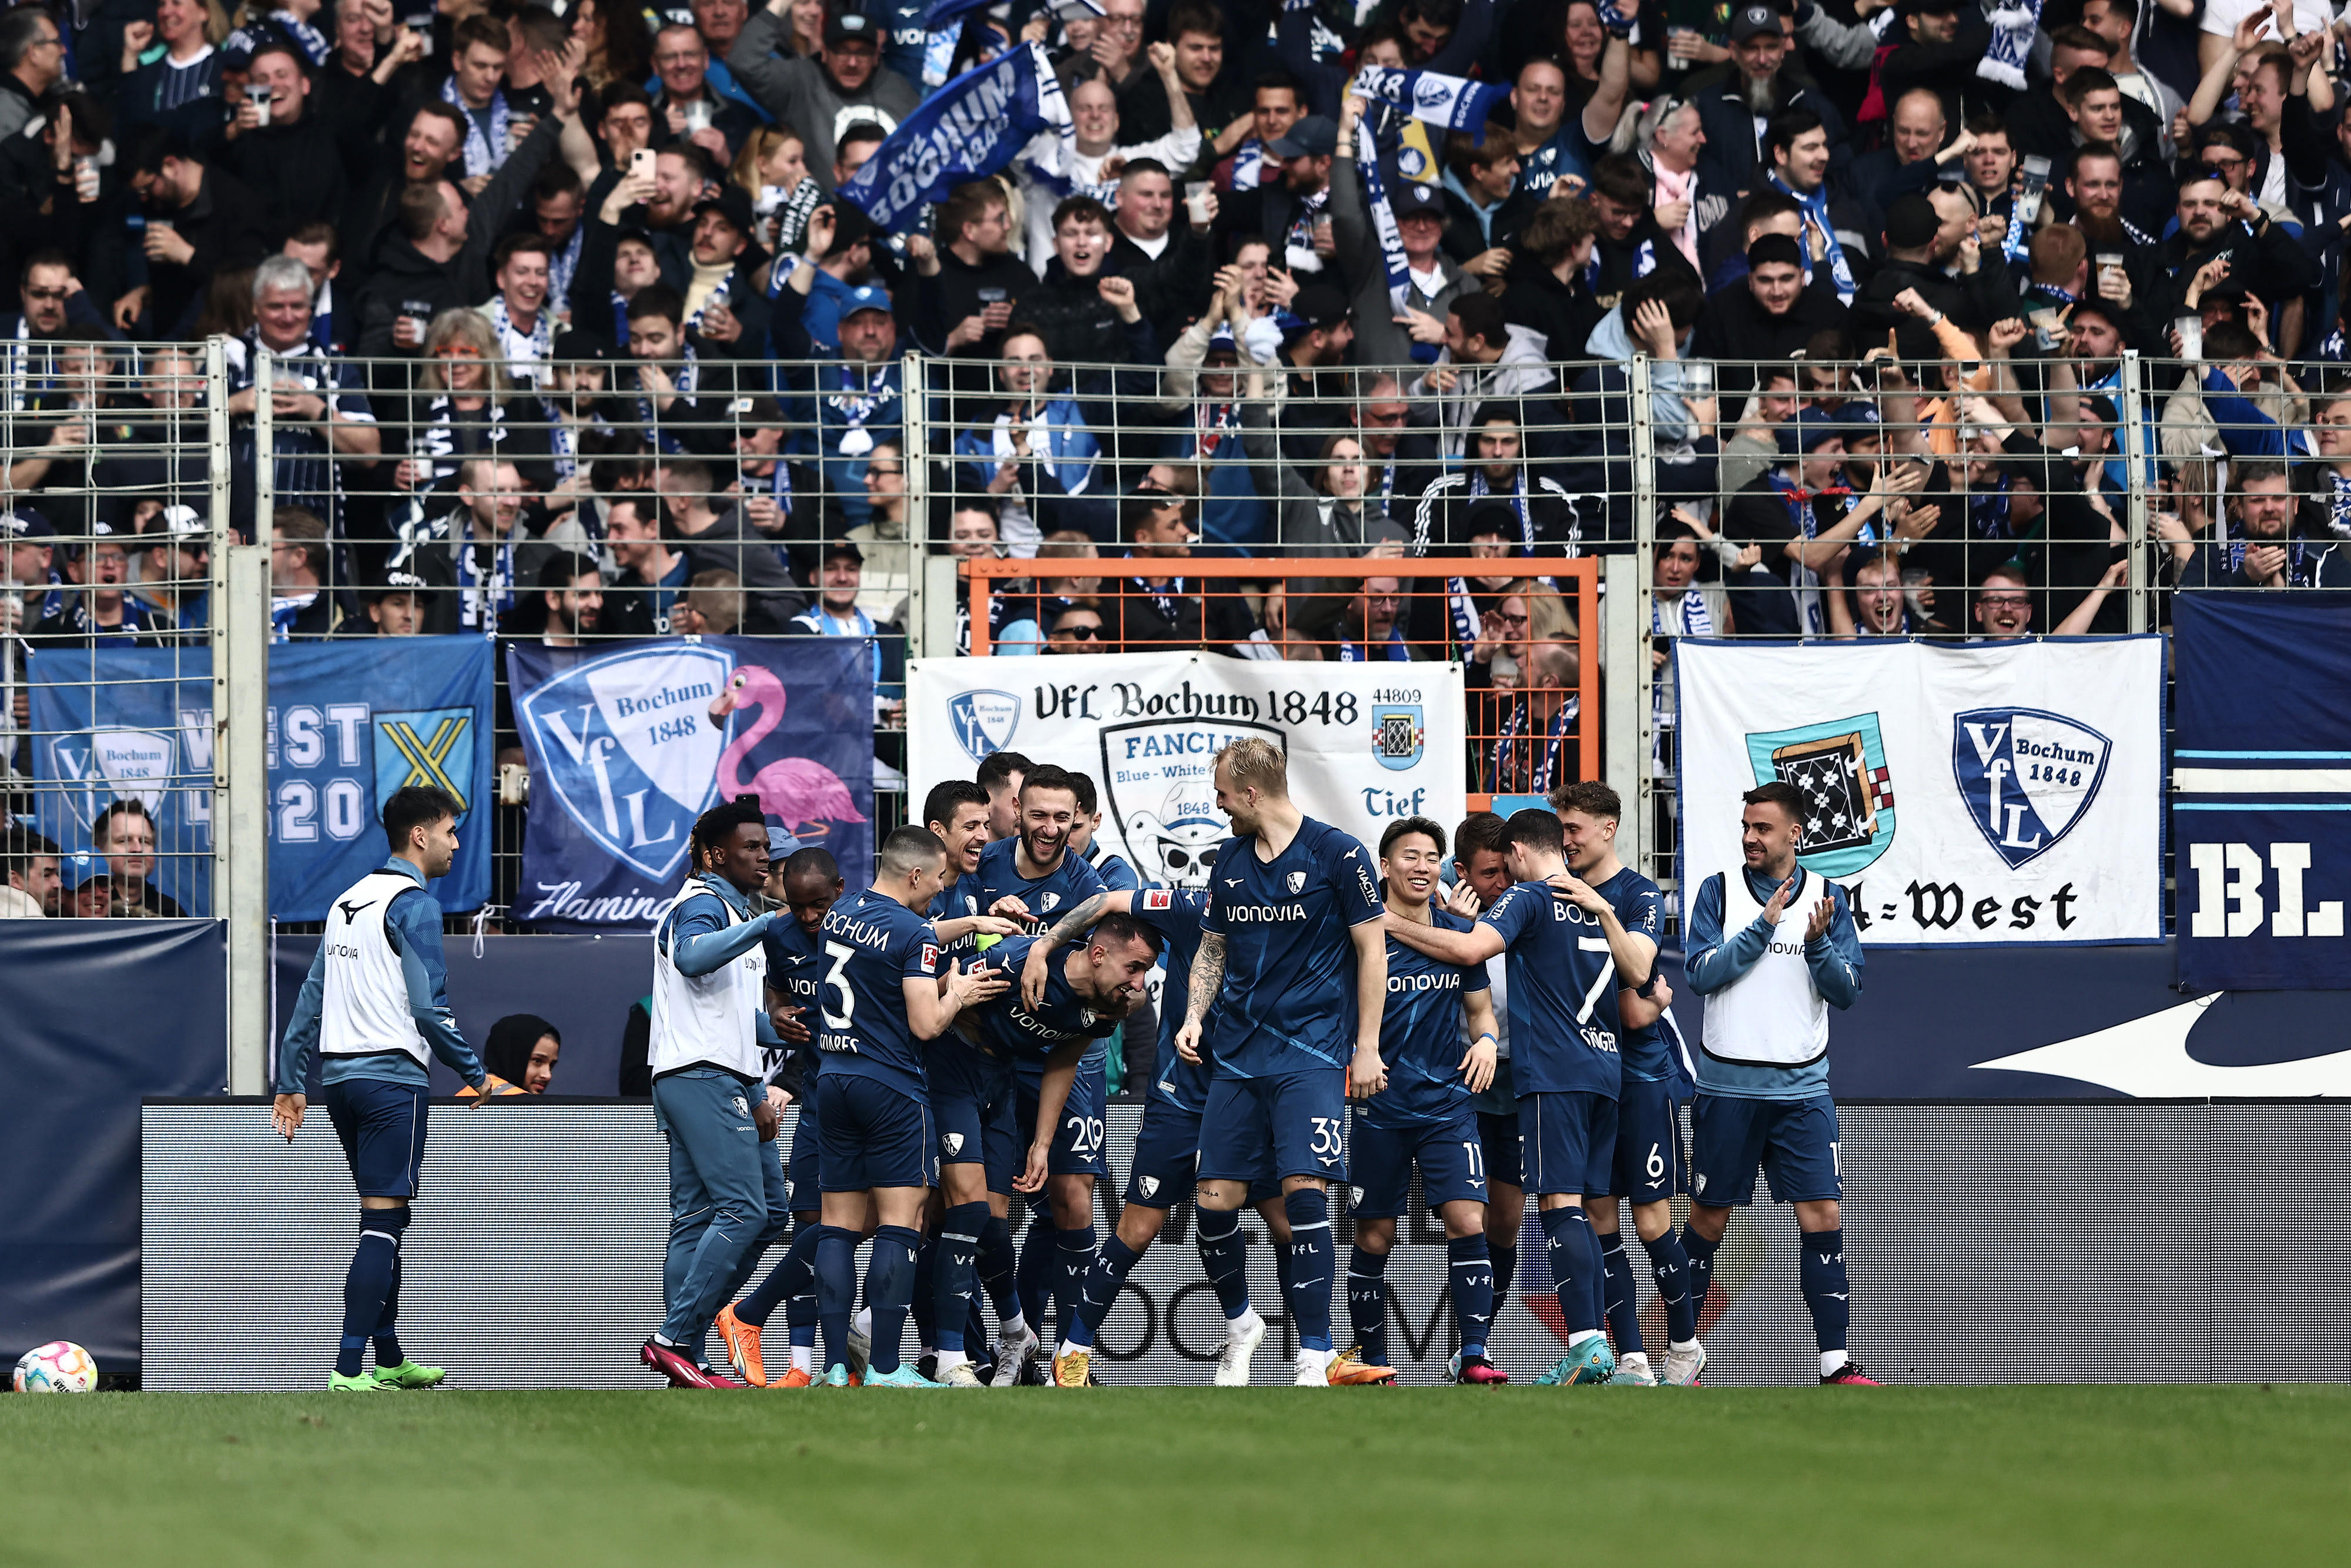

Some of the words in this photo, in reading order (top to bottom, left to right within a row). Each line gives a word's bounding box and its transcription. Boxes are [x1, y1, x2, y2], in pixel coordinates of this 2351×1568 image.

[616, 682, 714, 719] Bochum
[1034, 682, 1103, 721] VfL
[1112, 680, 1259, 722] Bochum
[1267, 690, 1359, 726] 1848
[1372, 688, 1422, 703] 44809
[647, 715, 697, 746] 1848
[106, 749, 162, 762] Bochum
[1125, 732, 1244, 759] FANCL
[2016, 739, 2094, 765] Bochum
[120, 767, 149, 778] 1848
[540, 703, 675, 849] VfL
[1116, 770, 1150, 783] Blue
[1162, 763, 1205, 778] White
[2030, 764, 2081, 786] 1848
[1963, 722, 2041, 850] VfL
[184, 778, 364, 845] 420
[1177, 802, 1210, 815] 1848
[1361, 788, 1425, 816] Tief
[1226, 903, 1307, 922] VONOVIA
[820, 908, 890, 951] OCHUM
[821, 940, 856, 1030] 3
[1387, 973, 1460, 992] ONOVIA
[1576, 936, 1616, 1025] 7
[1310, 1117, 1342, 1157] 33
[1463, 1142, 1484, 1178] 11
[1647, 1143, 1664, 1178] 6
[1292, 1243, 1319, 1255] VfL
[1548, 1236, 1563, 1251] fL
[954, 1254, 976, 1266] Vf
[1687, 1259, 1706, 1269] fL
[1820, 1252, 1843, 1264] Vf
[1067, 1265, 1090, 1276] Vf
[1653, 1264, 1679, 1278] fL
[1351, 1290, 1380, 1301] VfL
